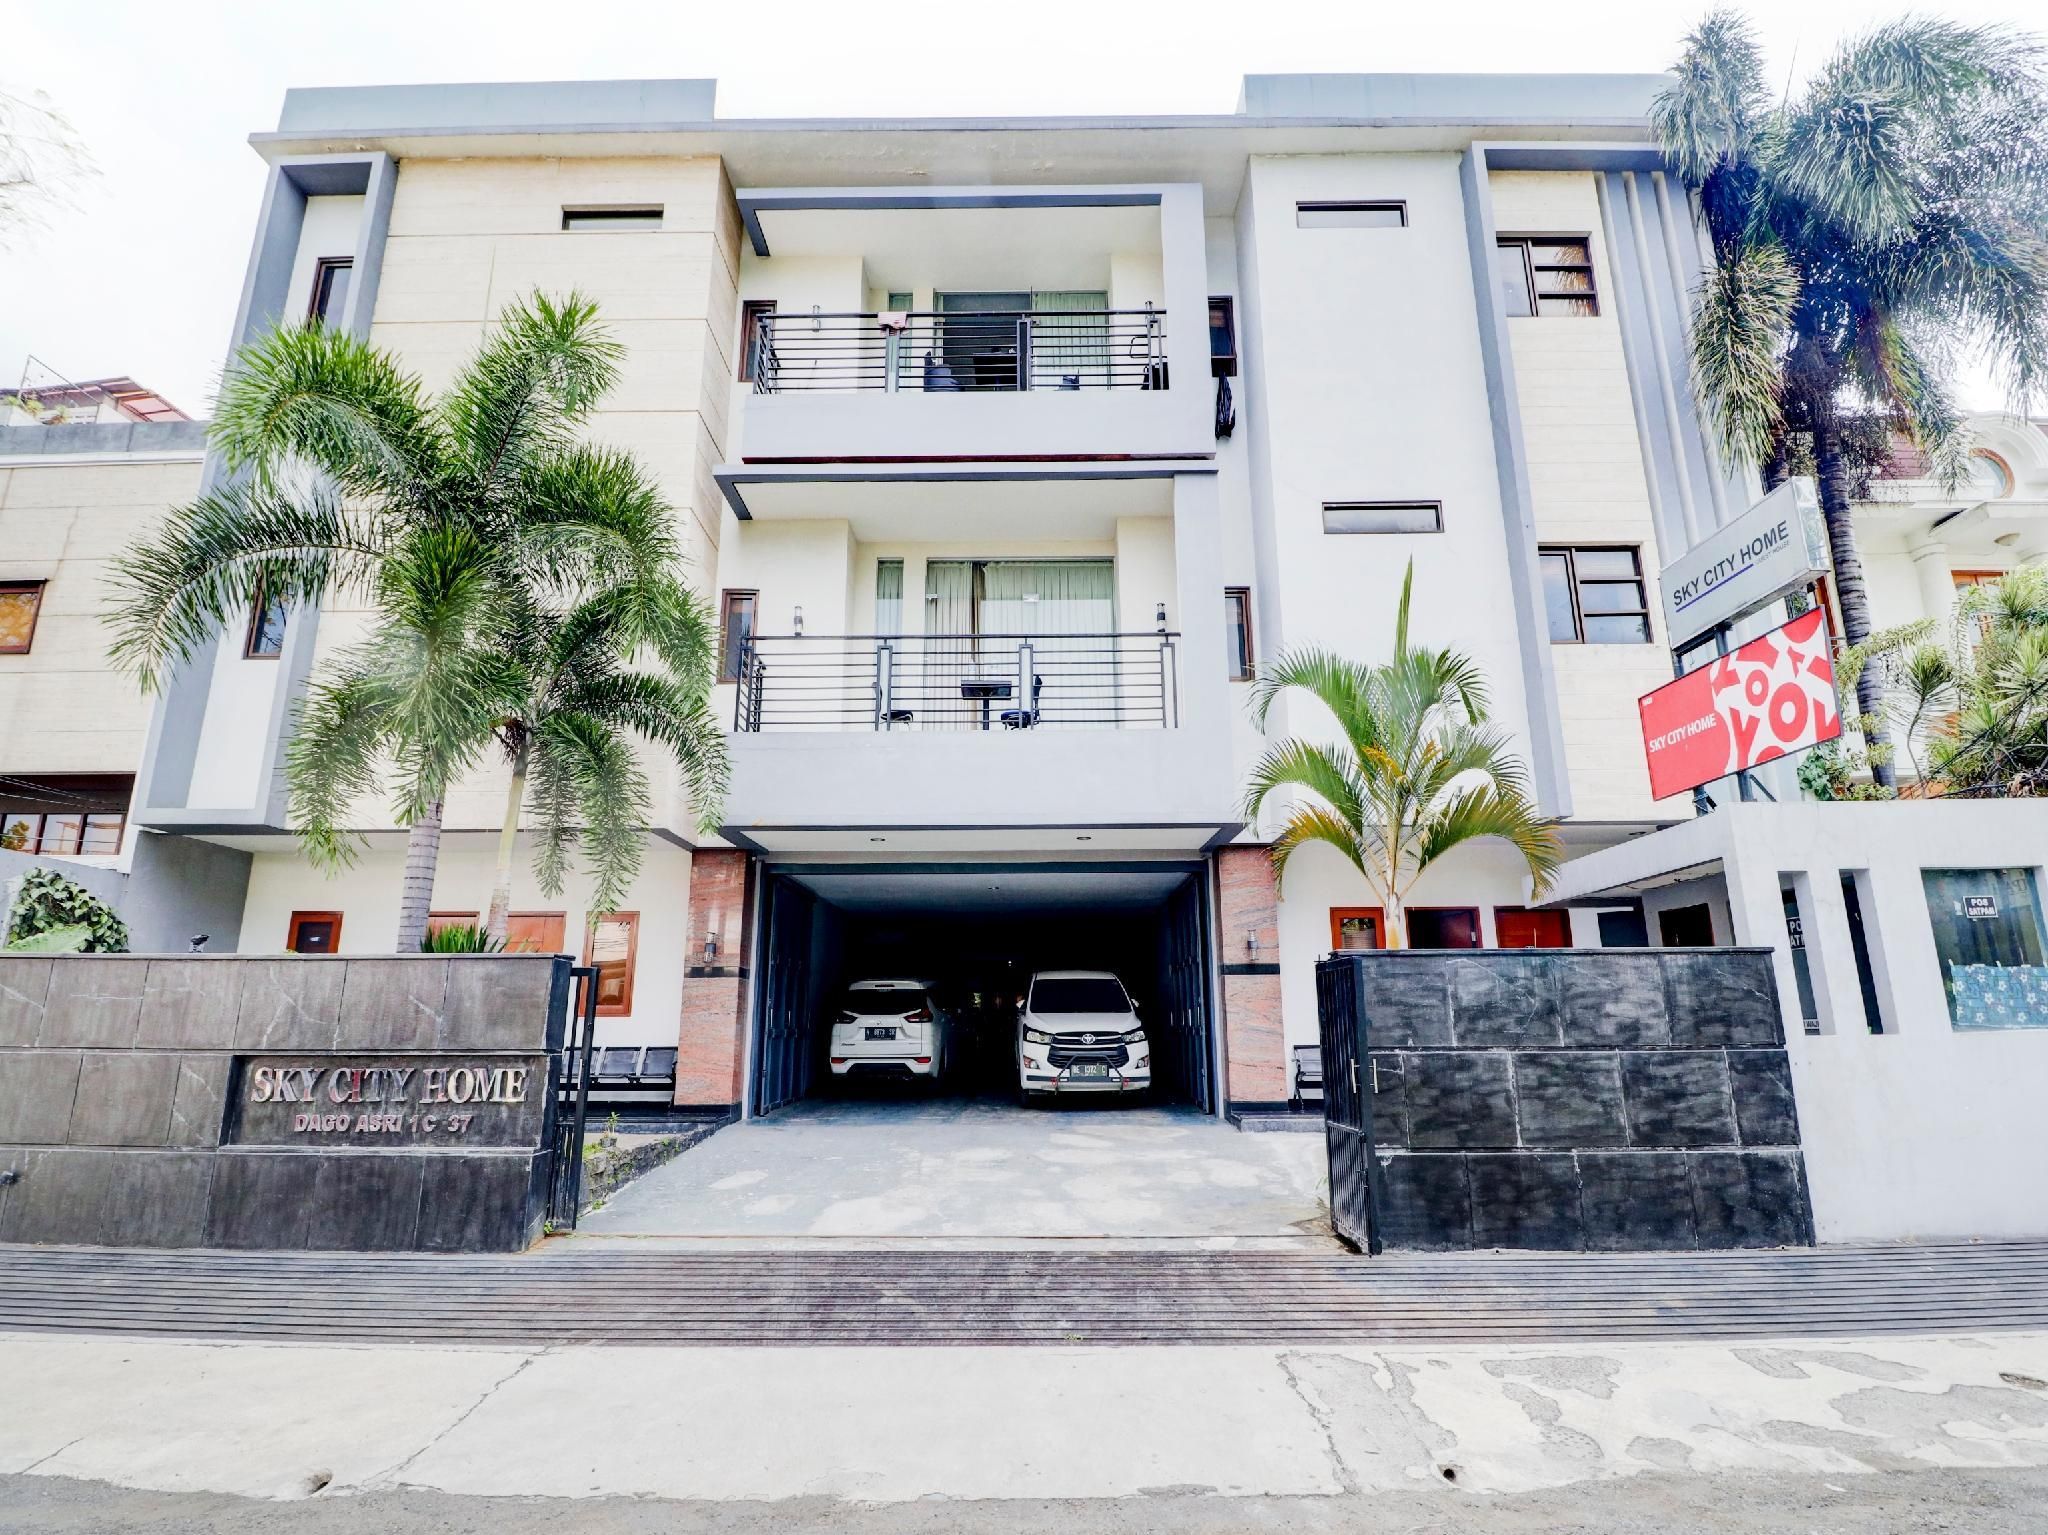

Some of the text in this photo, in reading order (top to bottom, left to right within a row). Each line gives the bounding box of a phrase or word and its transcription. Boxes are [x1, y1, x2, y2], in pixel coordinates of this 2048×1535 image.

[1673, 520, 1789, 606] SKY CITY HOME
[1649, 713, 1717, 753] SKY CITY HOME
[1971, 898, 1988, 906] POS
[250, 1067, 528, 1103] SKY CITY HOME
[294, 1115, 350, 1133] DAGO
[355, 1114, 403, 1133] ASRI
[447, 1115, 473, 1133] 37
